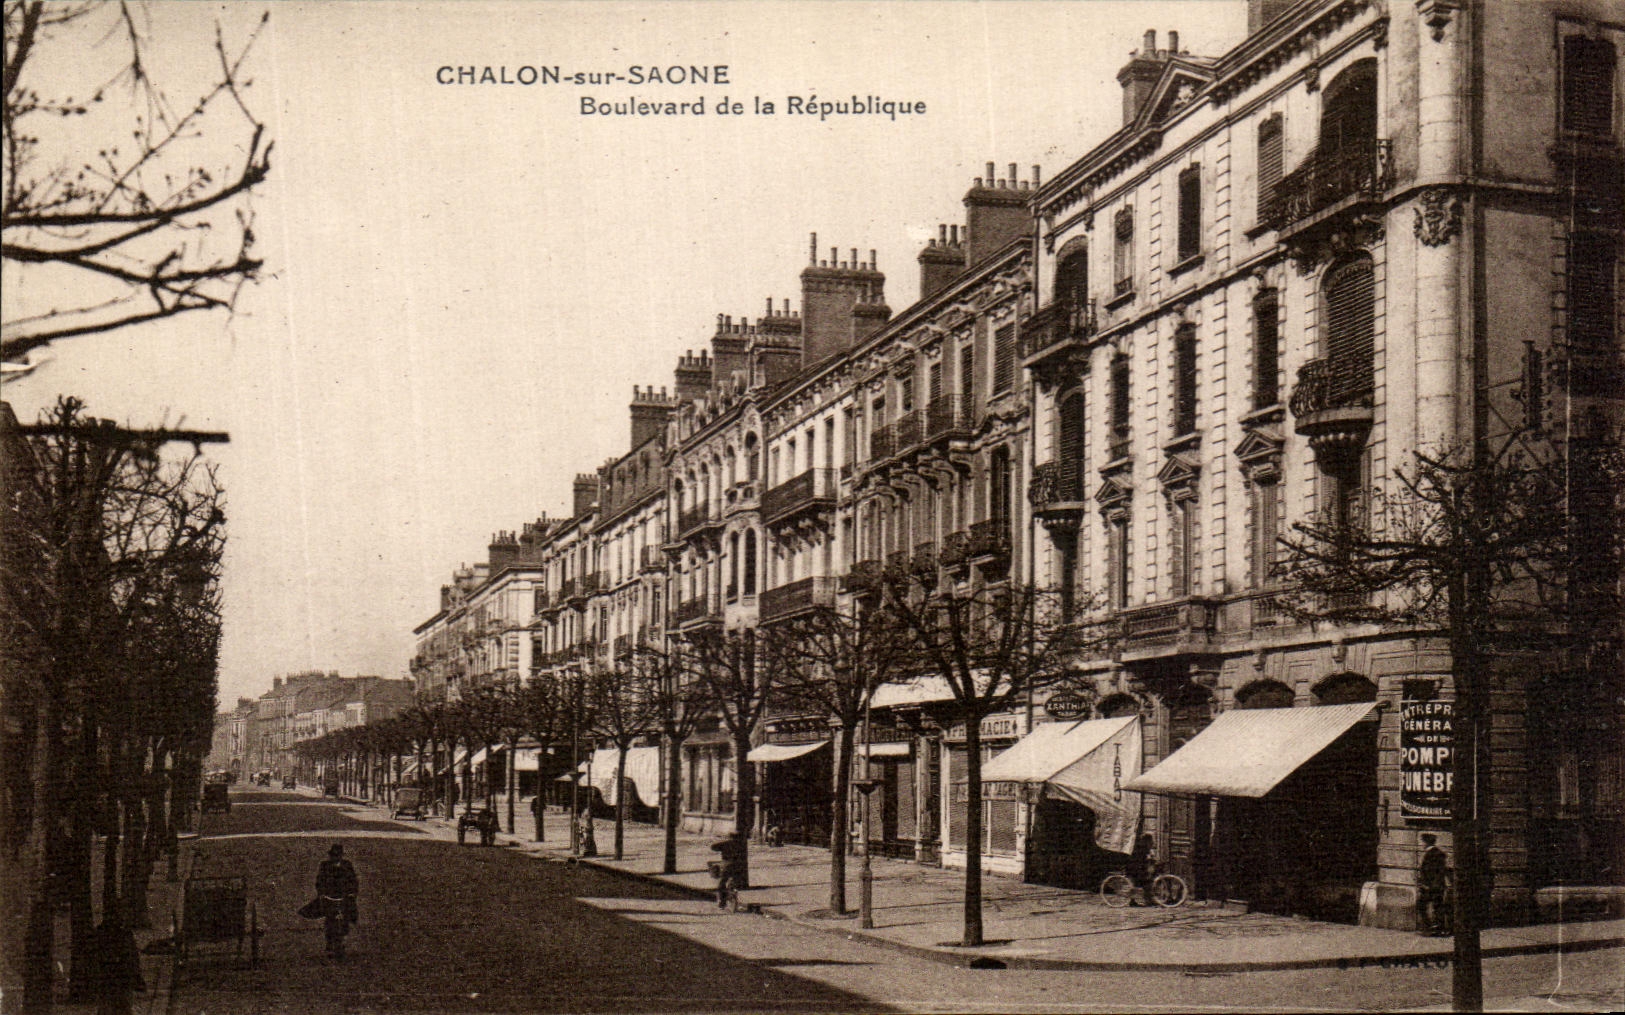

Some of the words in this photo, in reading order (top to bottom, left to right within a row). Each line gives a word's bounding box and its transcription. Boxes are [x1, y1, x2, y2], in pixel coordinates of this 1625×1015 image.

[1401, 703, 1455, 722] ENTREPR
[1404, 718, 1452, 732] GÉNÉRA
[1401, 747, 1455, 766] POMP
